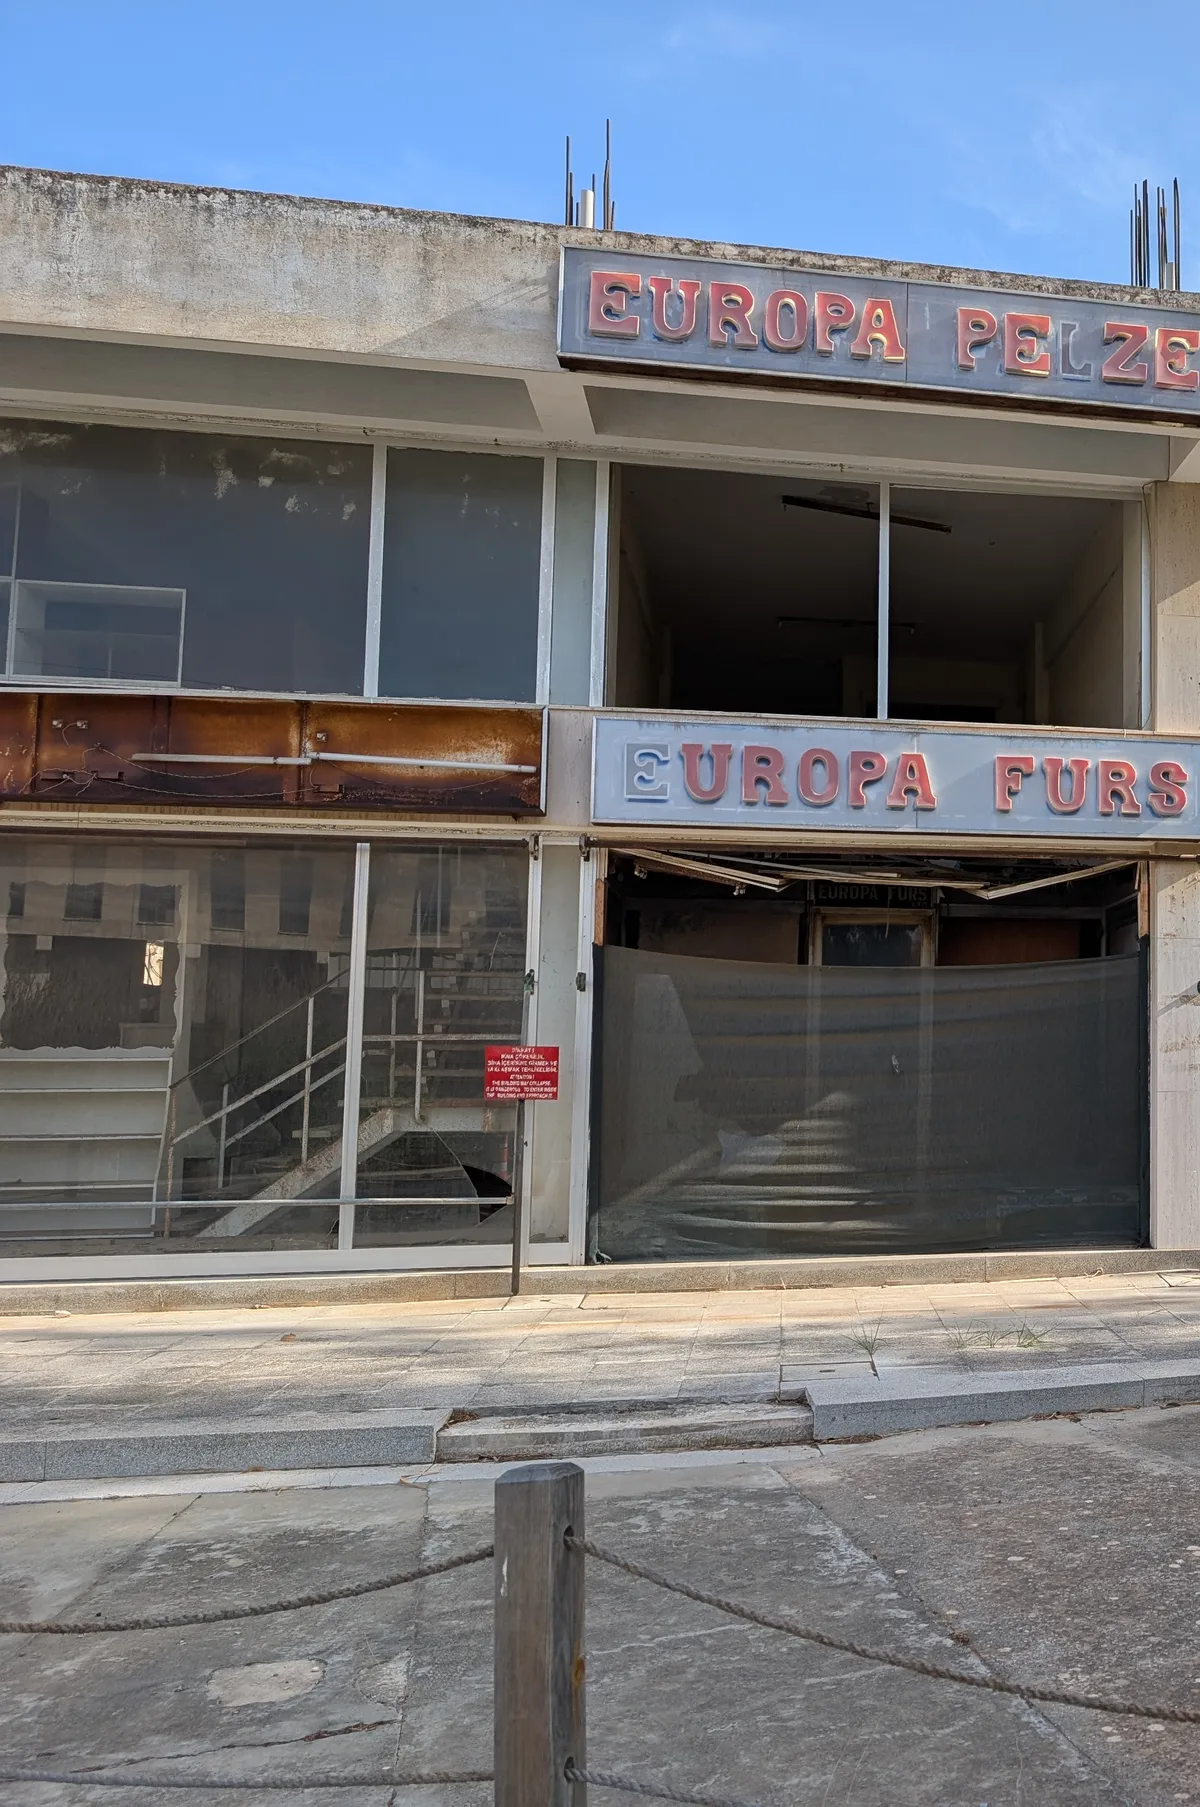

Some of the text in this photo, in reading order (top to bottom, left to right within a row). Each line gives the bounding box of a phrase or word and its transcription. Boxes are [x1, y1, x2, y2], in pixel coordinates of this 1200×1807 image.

[589, 271, 1200, 391] EUROPA PELZE
[624, 742, 1188, 816] EUROPA FURS
[818, 883, 928, 902] EUROPA FURS
